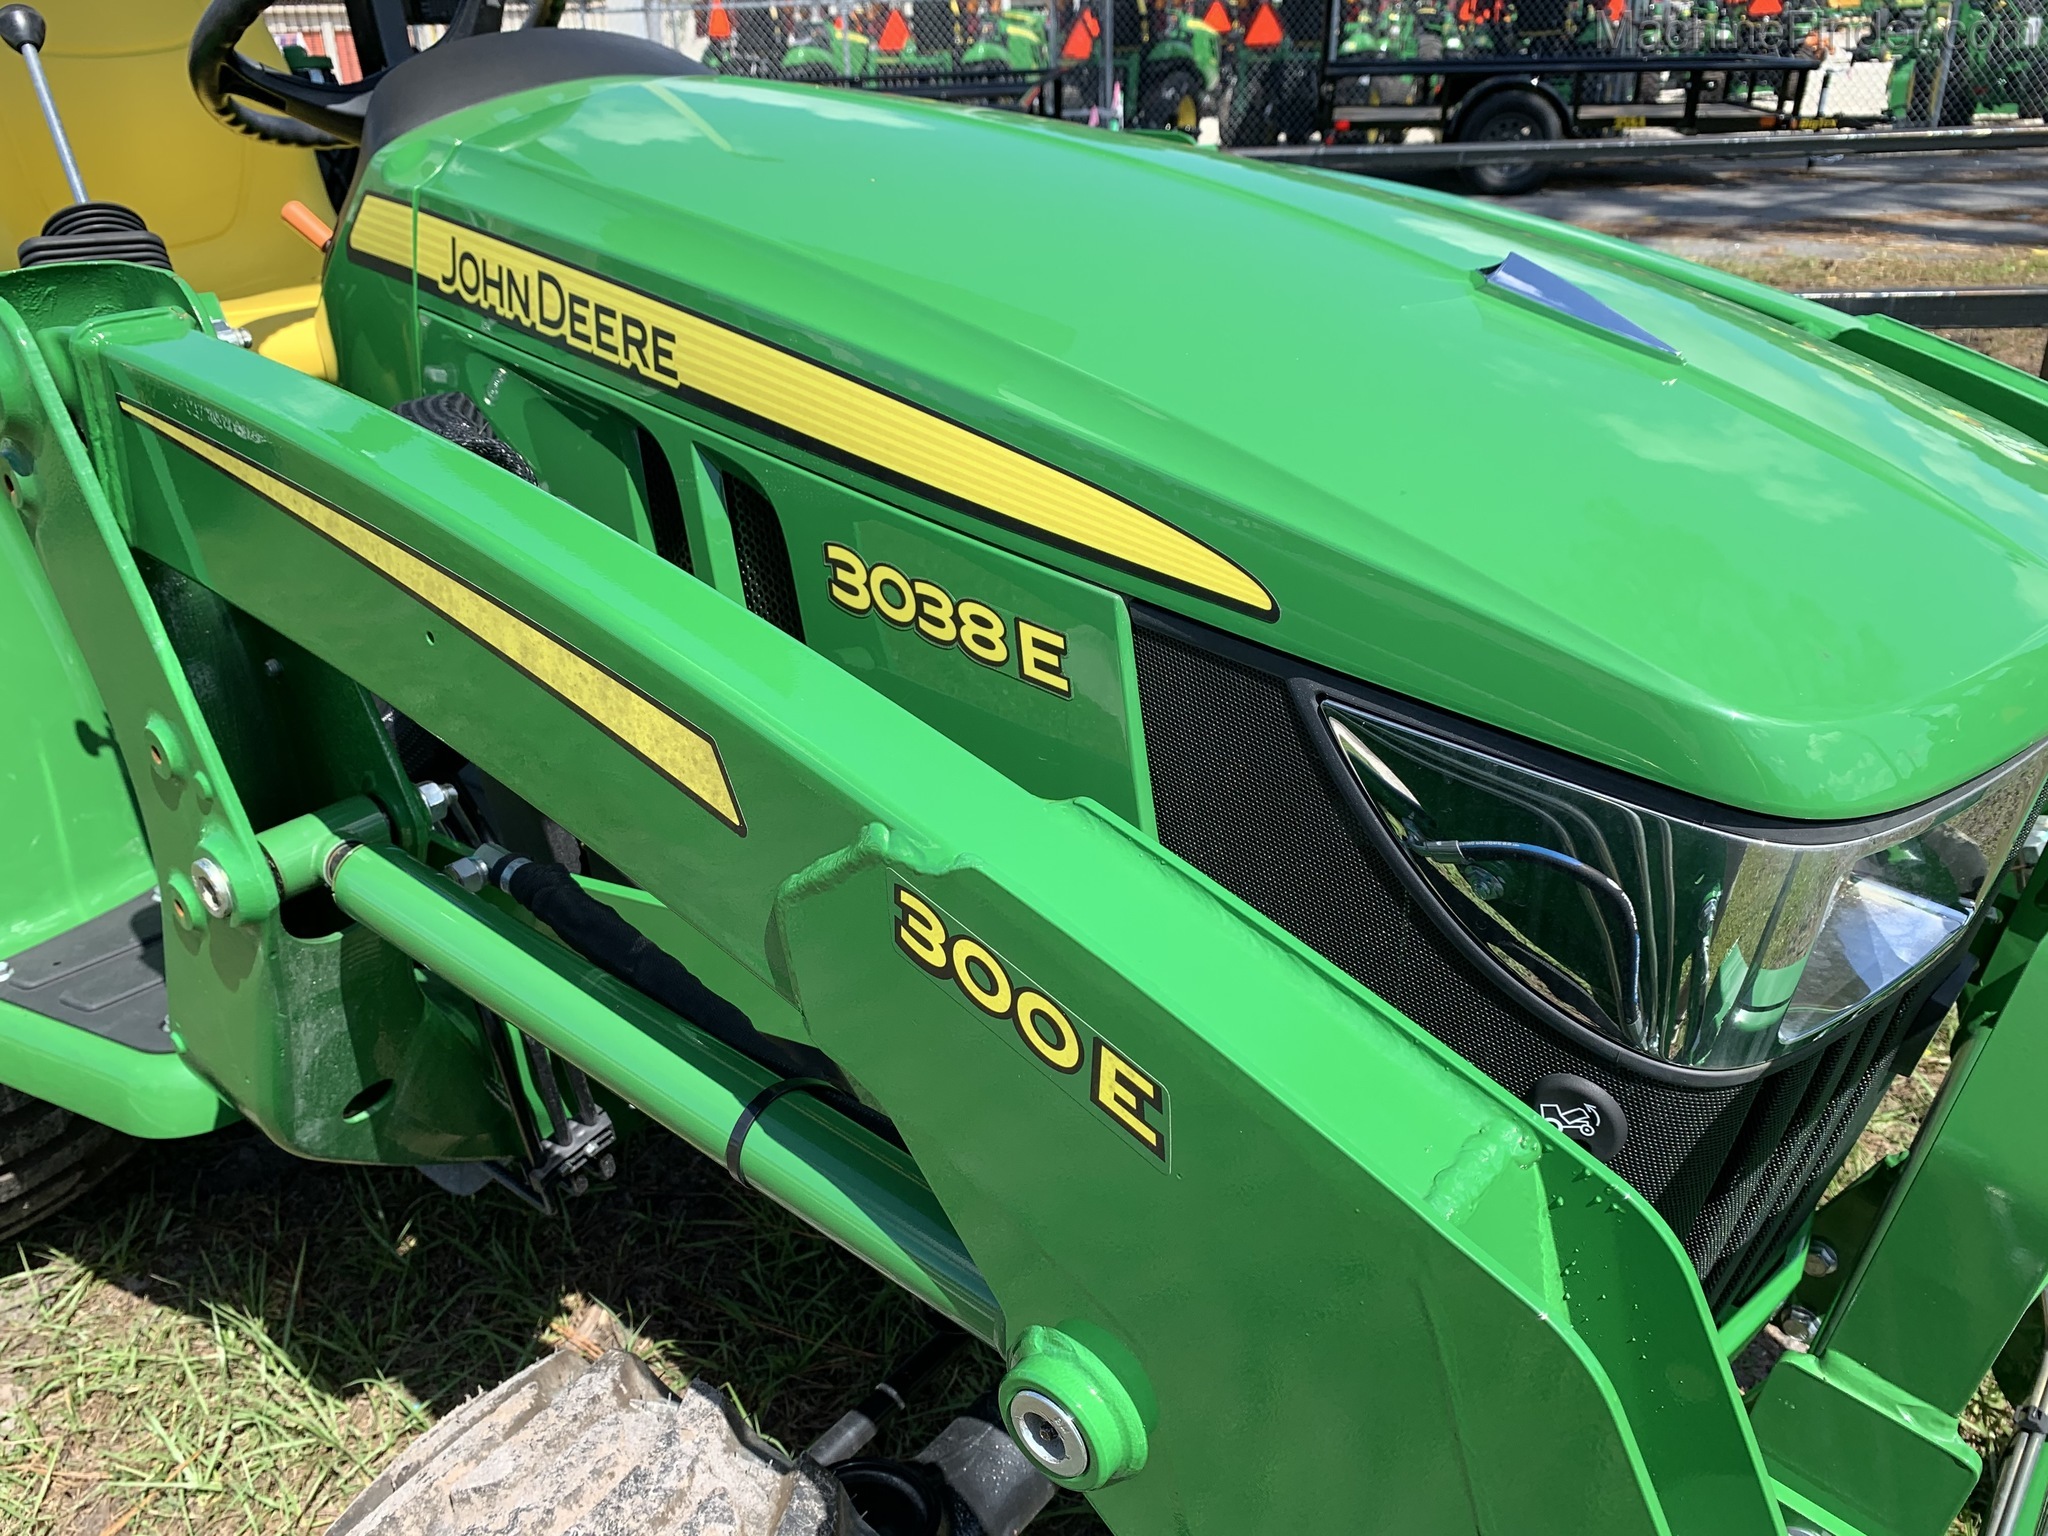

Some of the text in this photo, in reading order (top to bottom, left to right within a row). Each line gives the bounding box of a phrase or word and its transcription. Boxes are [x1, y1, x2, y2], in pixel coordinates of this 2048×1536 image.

[439, 235, 679, 383] JOHN DEERE
[824, 541, 1074, 700] 3038 E
[893, 883, 1166, 1163] 300 E
